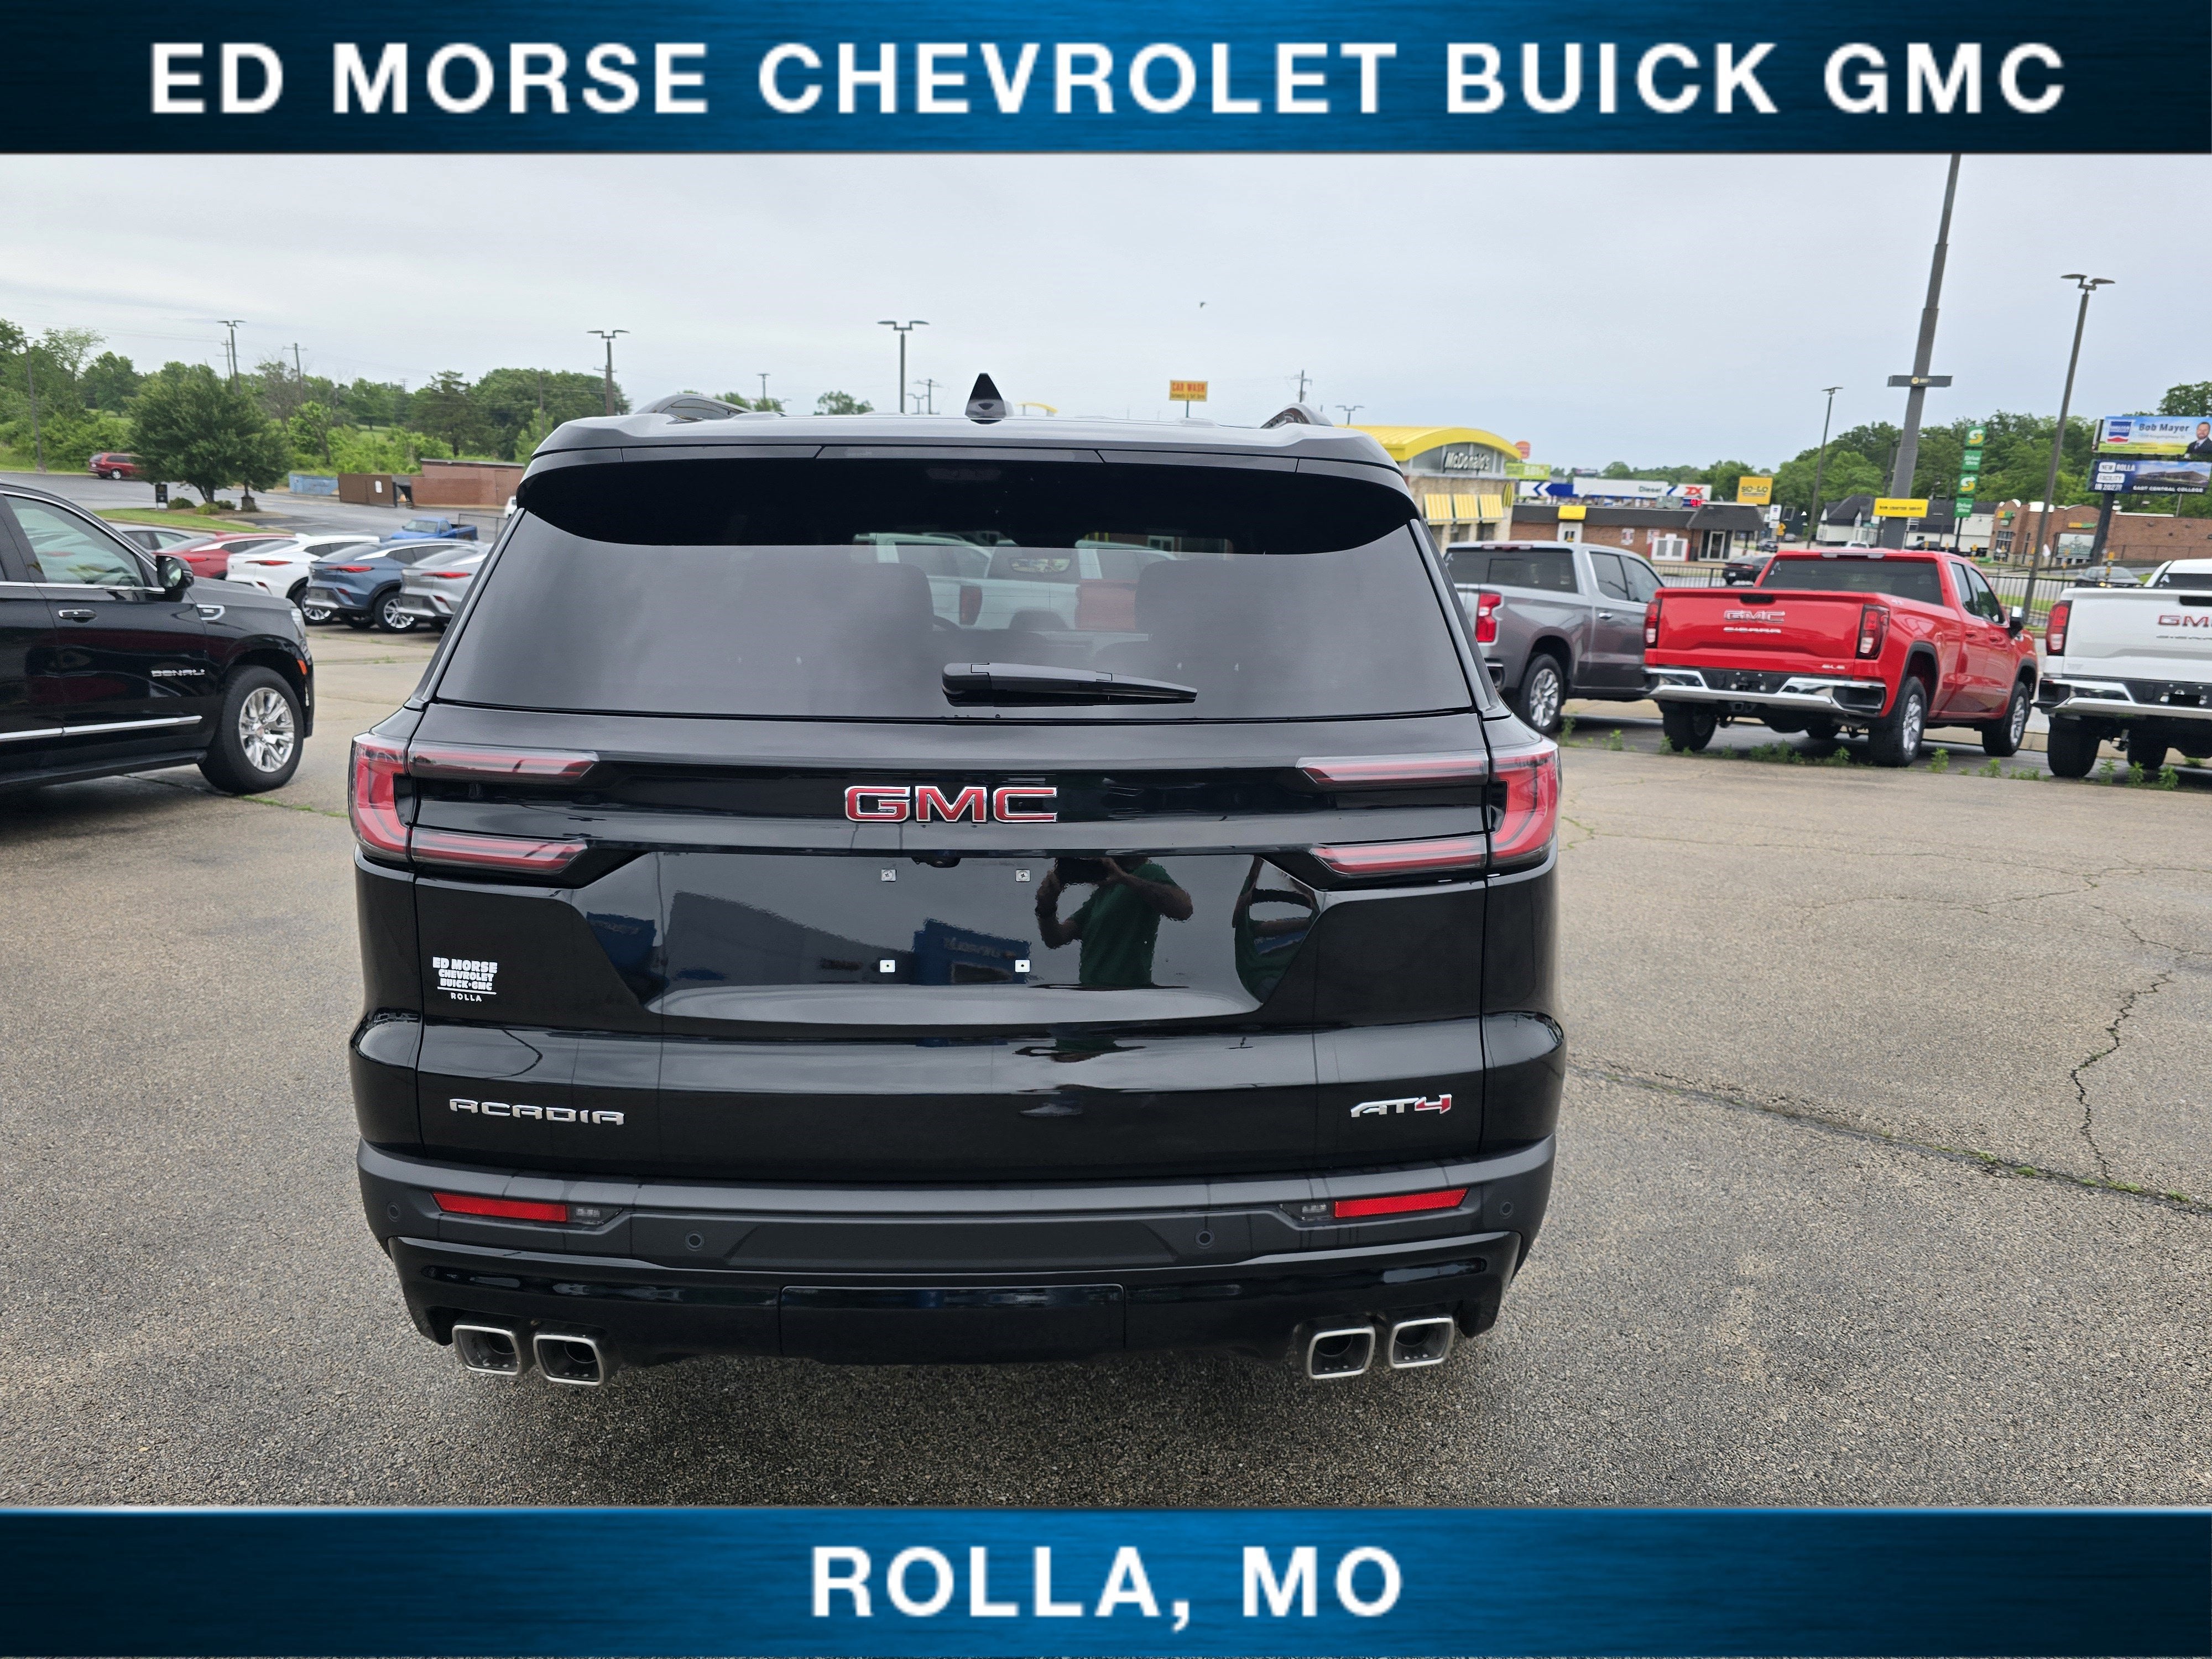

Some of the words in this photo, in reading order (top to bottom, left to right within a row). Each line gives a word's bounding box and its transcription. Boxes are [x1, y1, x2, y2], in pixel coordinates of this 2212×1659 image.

[2159, 423, 2190, 434] Mayer
[1723, 609, 1786, 623] GMC
[2158, 615, 2212, 628] GM
[150, 669, 205, 677] DENALI
[844, 785, 1058, 823] GMC
[432, 956, 450, 969] ED
[451, 958, 498, 974] MORSE
[438, 968, 494, 982] CHEVROLET
[450, 992, 482, 1002] ROLLA
[448, 1098, 625, 1126] ACADIA
[1350, 1093, 1453, 1118] AT4
